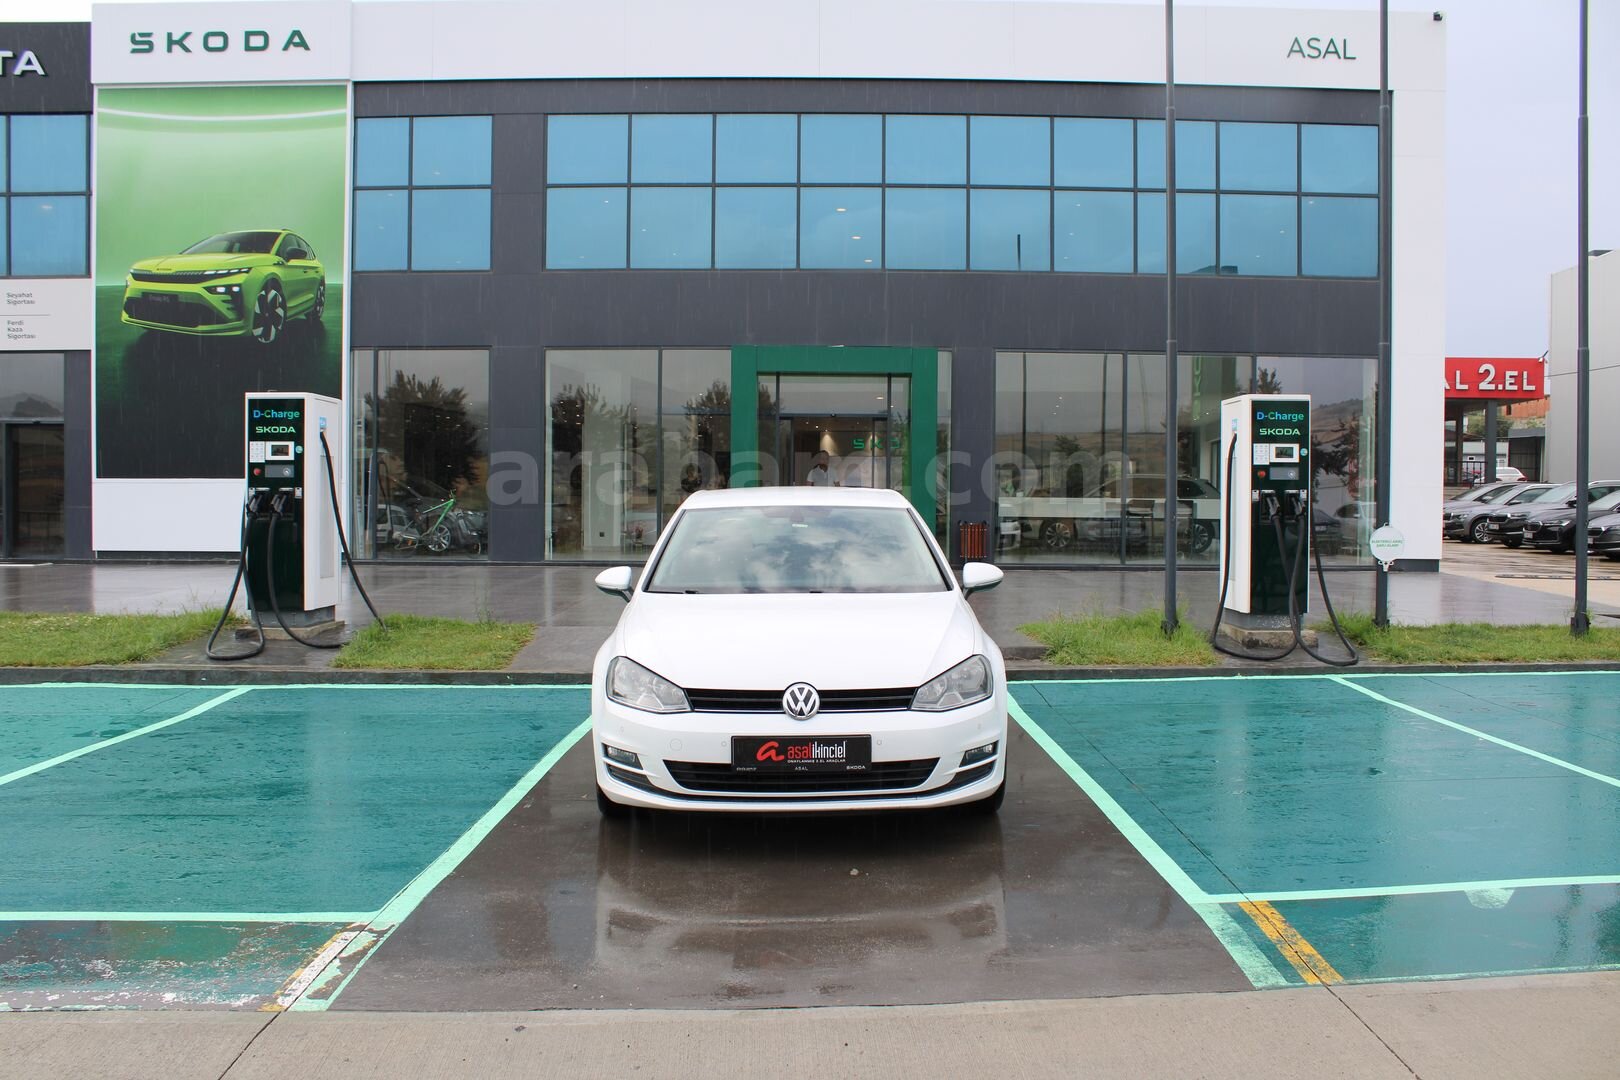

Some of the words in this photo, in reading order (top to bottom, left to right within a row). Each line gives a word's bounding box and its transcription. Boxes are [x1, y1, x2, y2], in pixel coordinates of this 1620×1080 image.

[1287, 37, 1357, 60] ASAL
[1478, 363, 1536, 391] 2.EL
[253, 409, 300, 420] D-Charge
[1256, 411, 1304, 422] D-Charge
